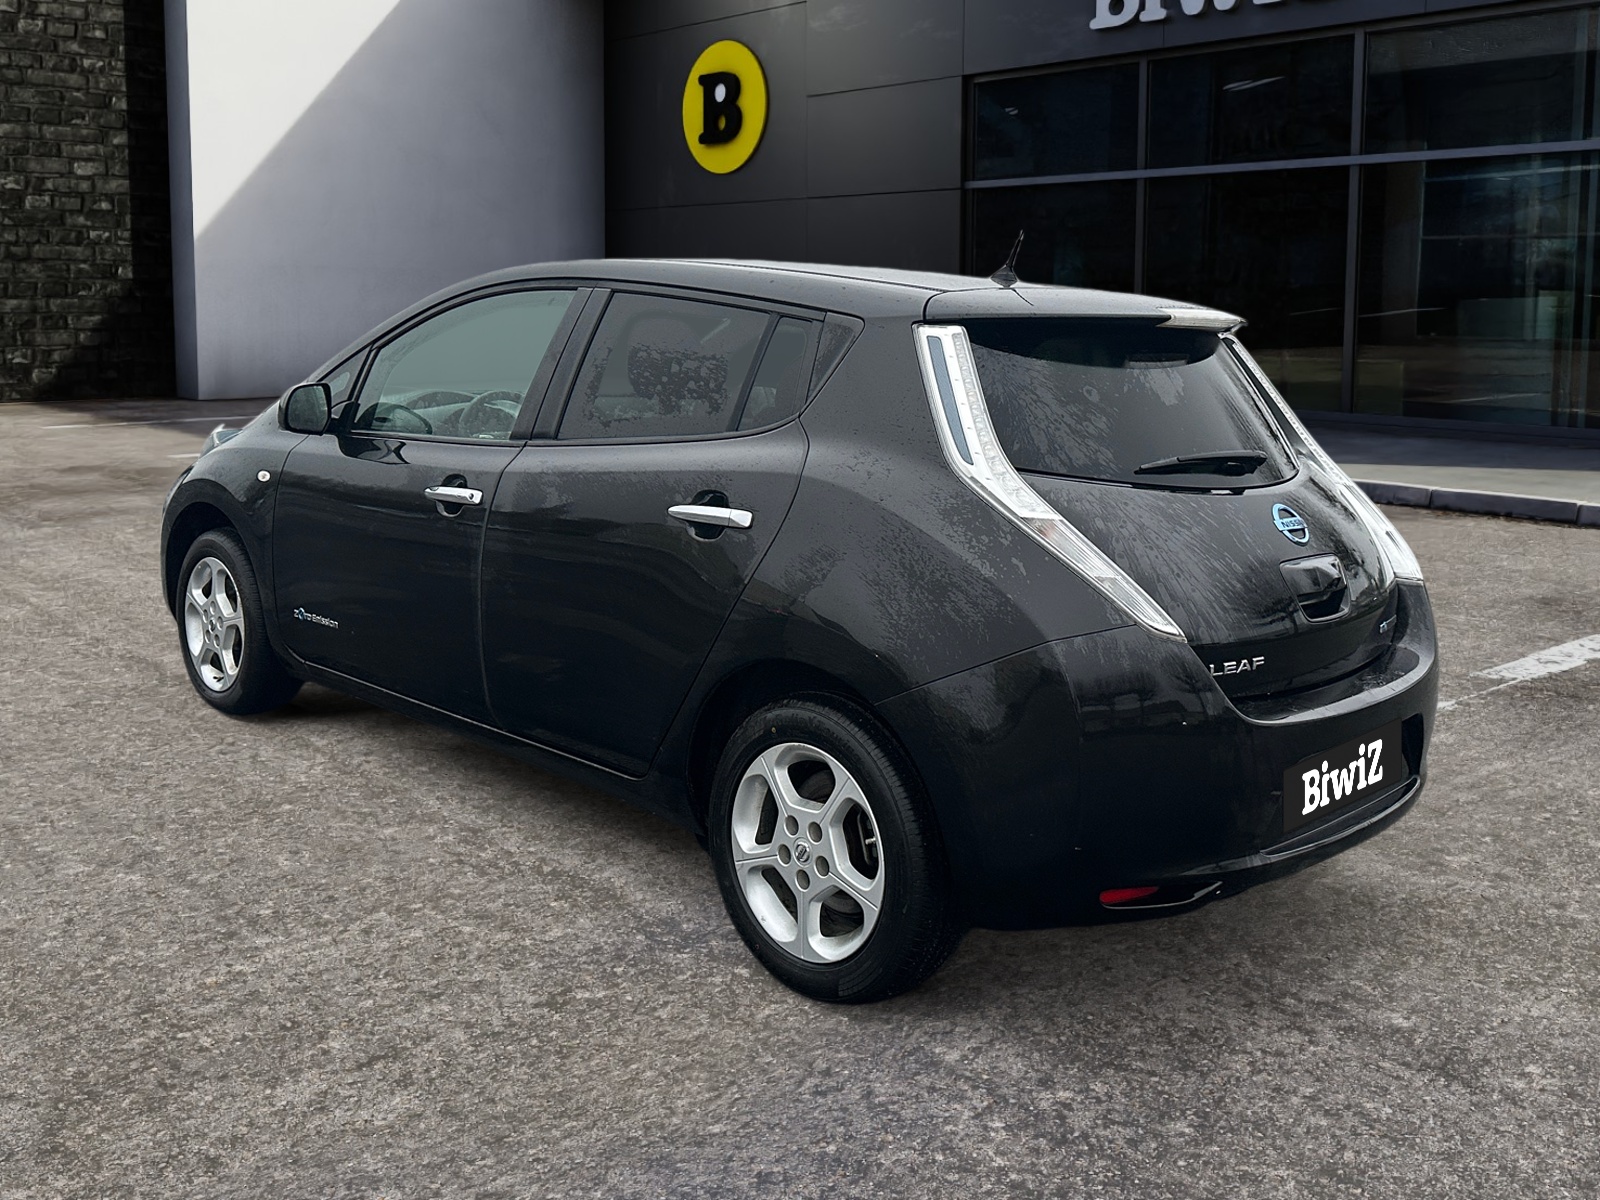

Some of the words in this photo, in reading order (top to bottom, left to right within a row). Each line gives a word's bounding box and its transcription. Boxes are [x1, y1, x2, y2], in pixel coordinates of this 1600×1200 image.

[698, 72, 742, 144] B
[1209, 656, 1265, 676] LEAF
[1301, 738, 1384, 816] BiwiZ
